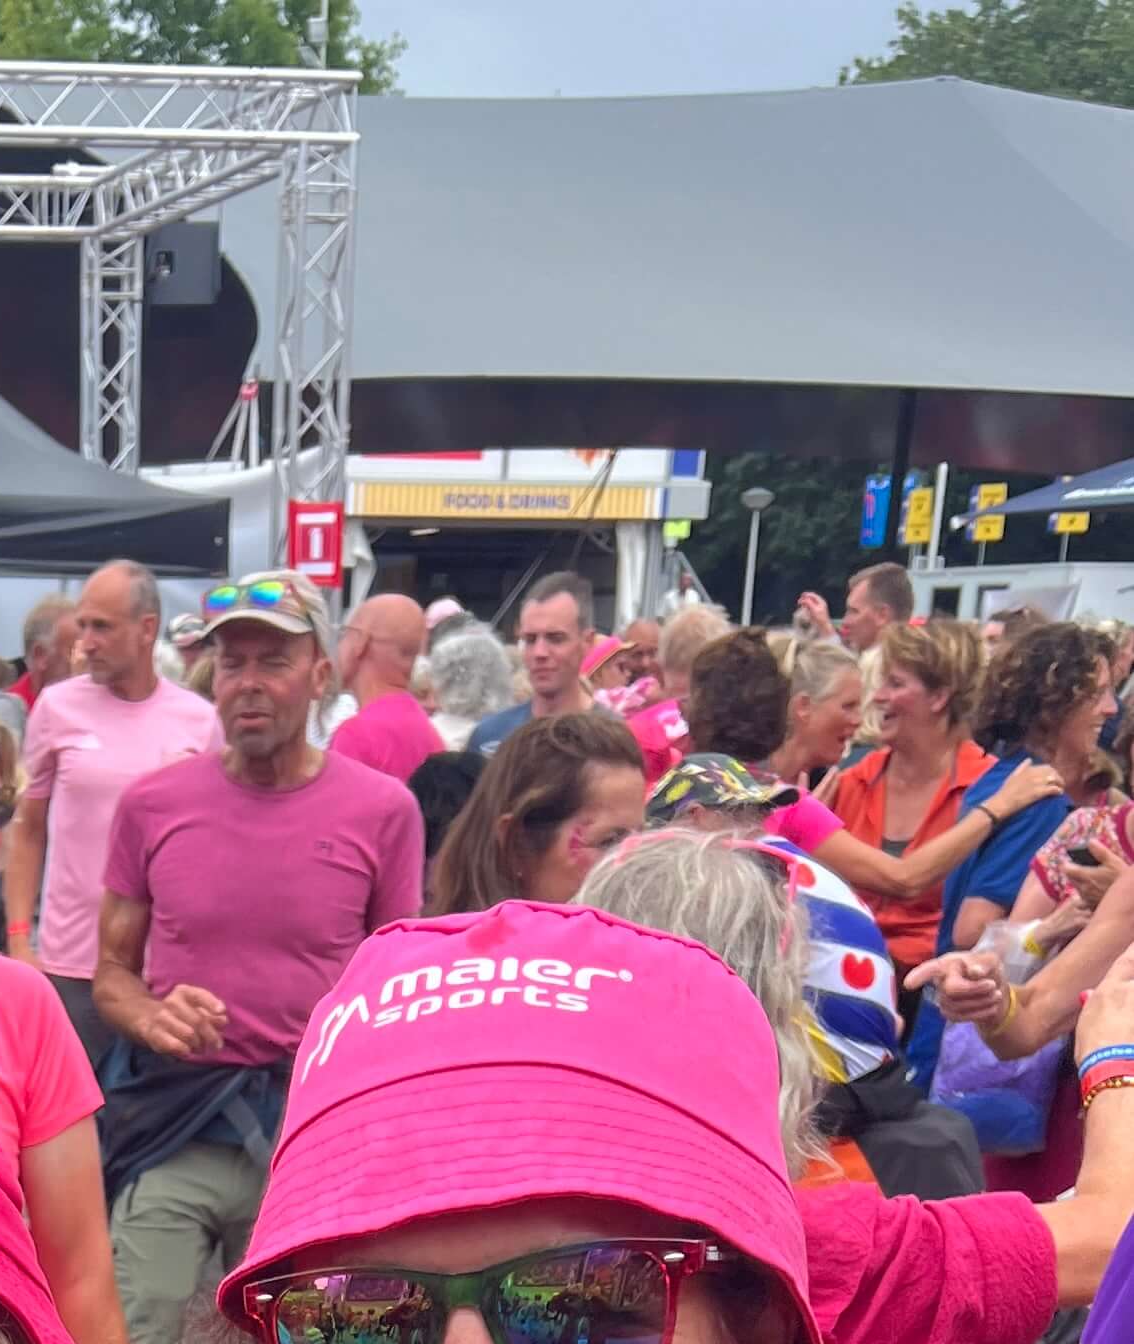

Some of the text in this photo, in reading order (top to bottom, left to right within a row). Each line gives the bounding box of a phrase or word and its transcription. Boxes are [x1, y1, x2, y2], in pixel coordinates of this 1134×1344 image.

[444, 493, 492, 509] FOOD
[508, 493, 571, 510] DRINKS
[373, 985, 589, 1028] sports
